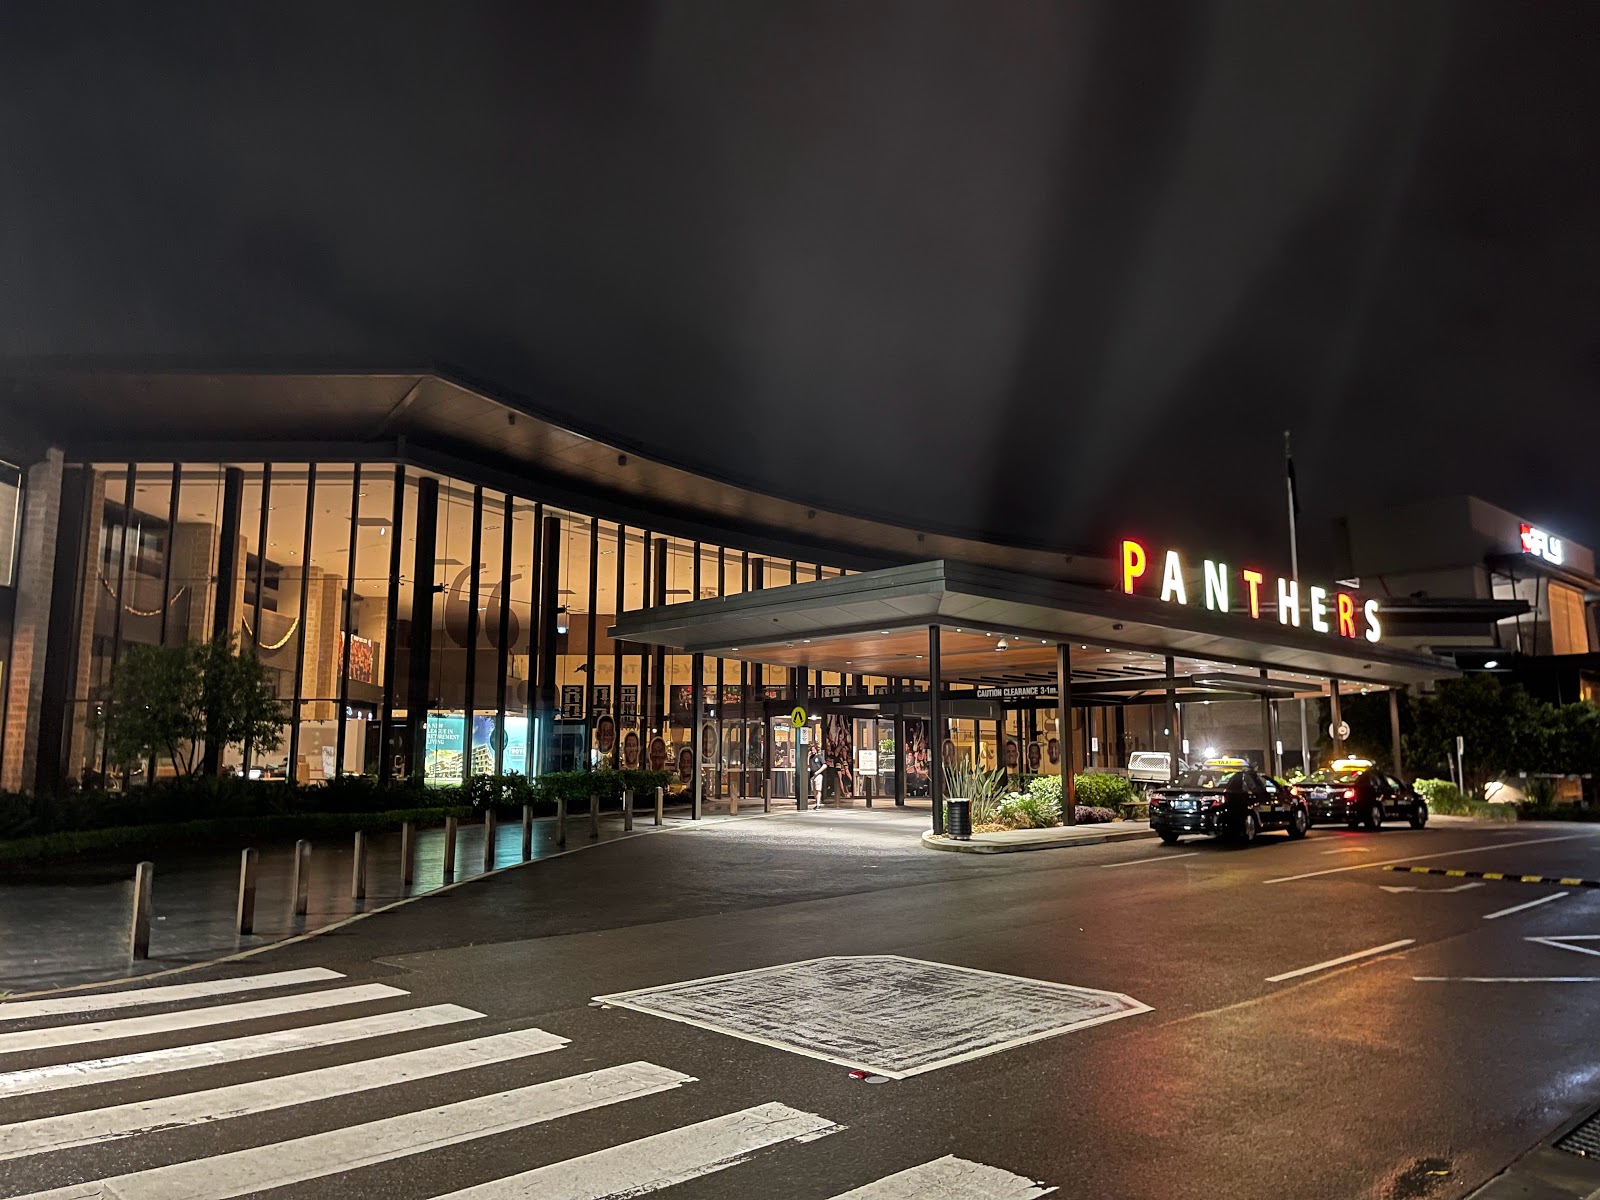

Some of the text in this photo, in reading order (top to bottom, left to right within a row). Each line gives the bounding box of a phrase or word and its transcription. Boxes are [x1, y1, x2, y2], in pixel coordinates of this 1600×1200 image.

[1122, 540, 1381, 643] PANTHERS
[977, 689, 1002, 698] CAUTION
[1003, 686, 1039, 697] CLEARANCE
